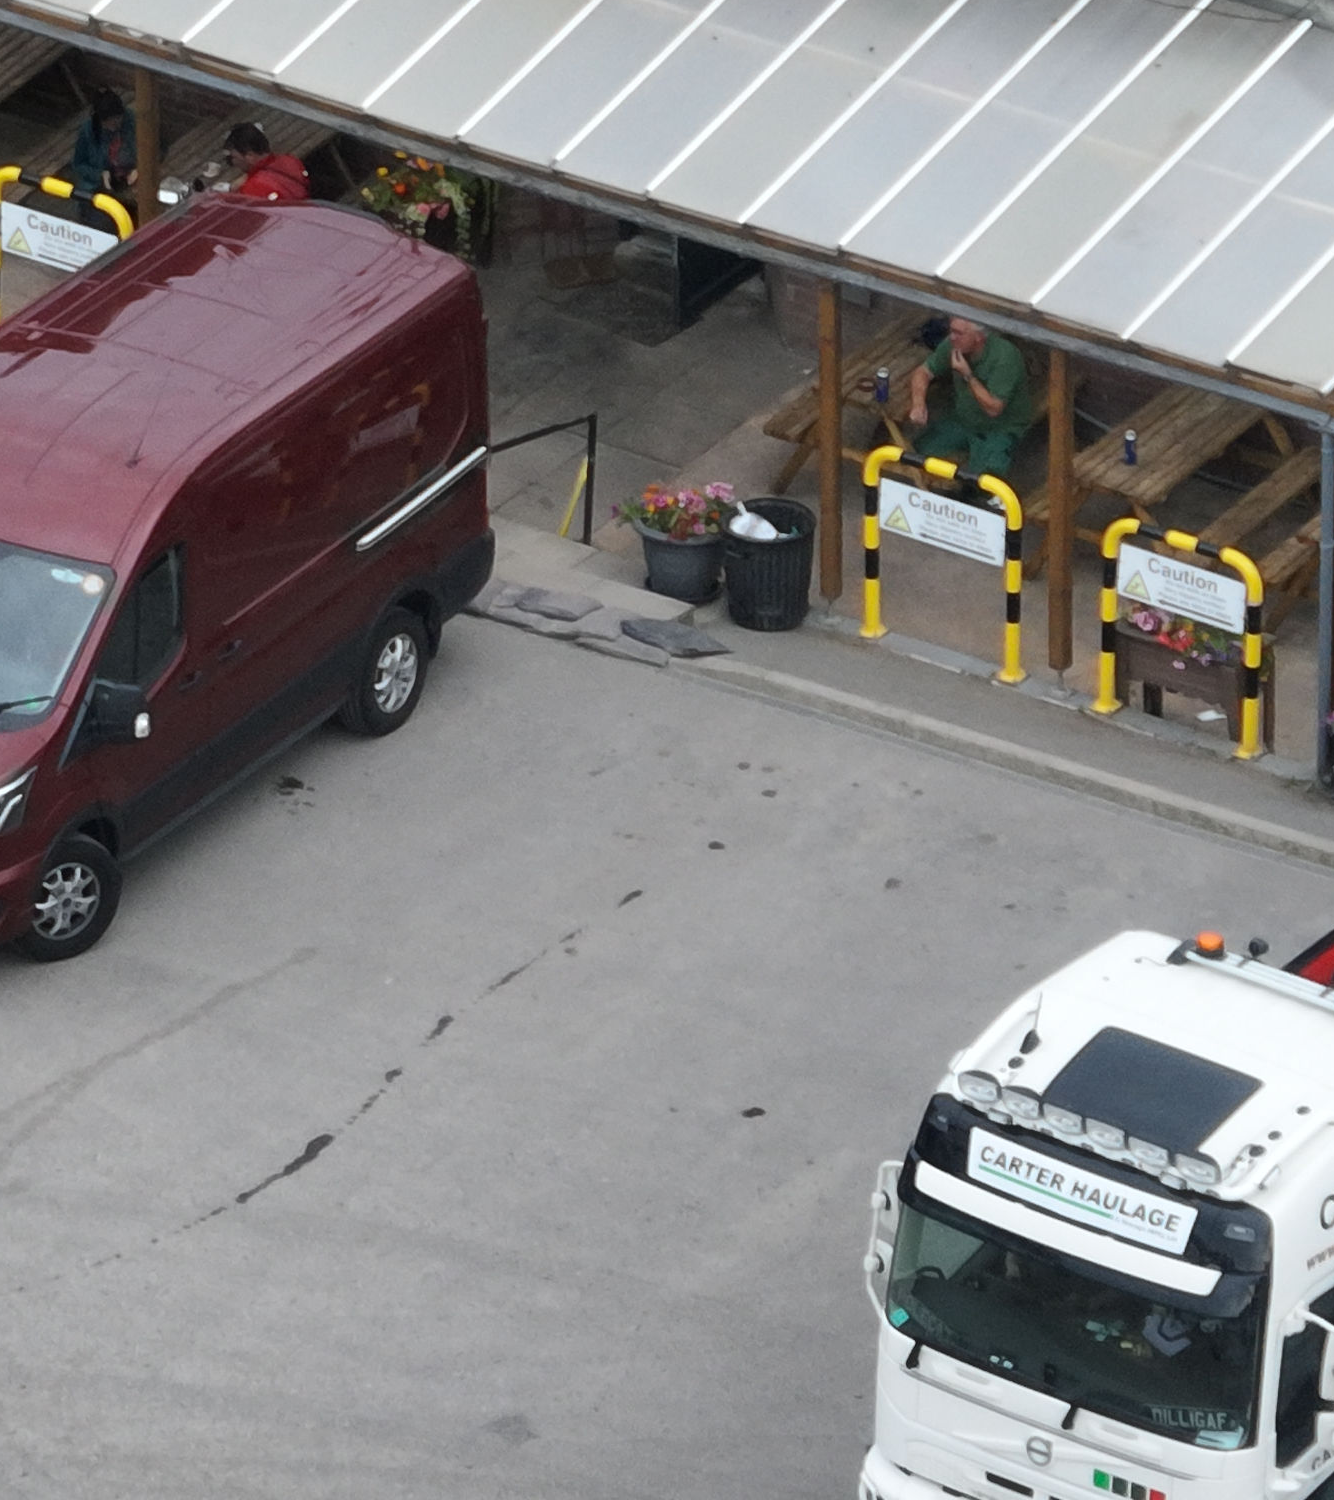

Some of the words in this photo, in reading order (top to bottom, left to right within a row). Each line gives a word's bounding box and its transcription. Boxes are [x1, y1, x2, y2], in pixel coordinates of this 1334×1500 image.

[26, 213, 94, 247] Caution
[907, 491, 979, 530] Caution
[1147, 557, 1219, 595] Caution
[980, 1145, 1066, 1193] CARTER
[1070, 1180, 1182, 1234] HAULAGE
[1151, 1406, 1228, 1431] DILLIGAF
